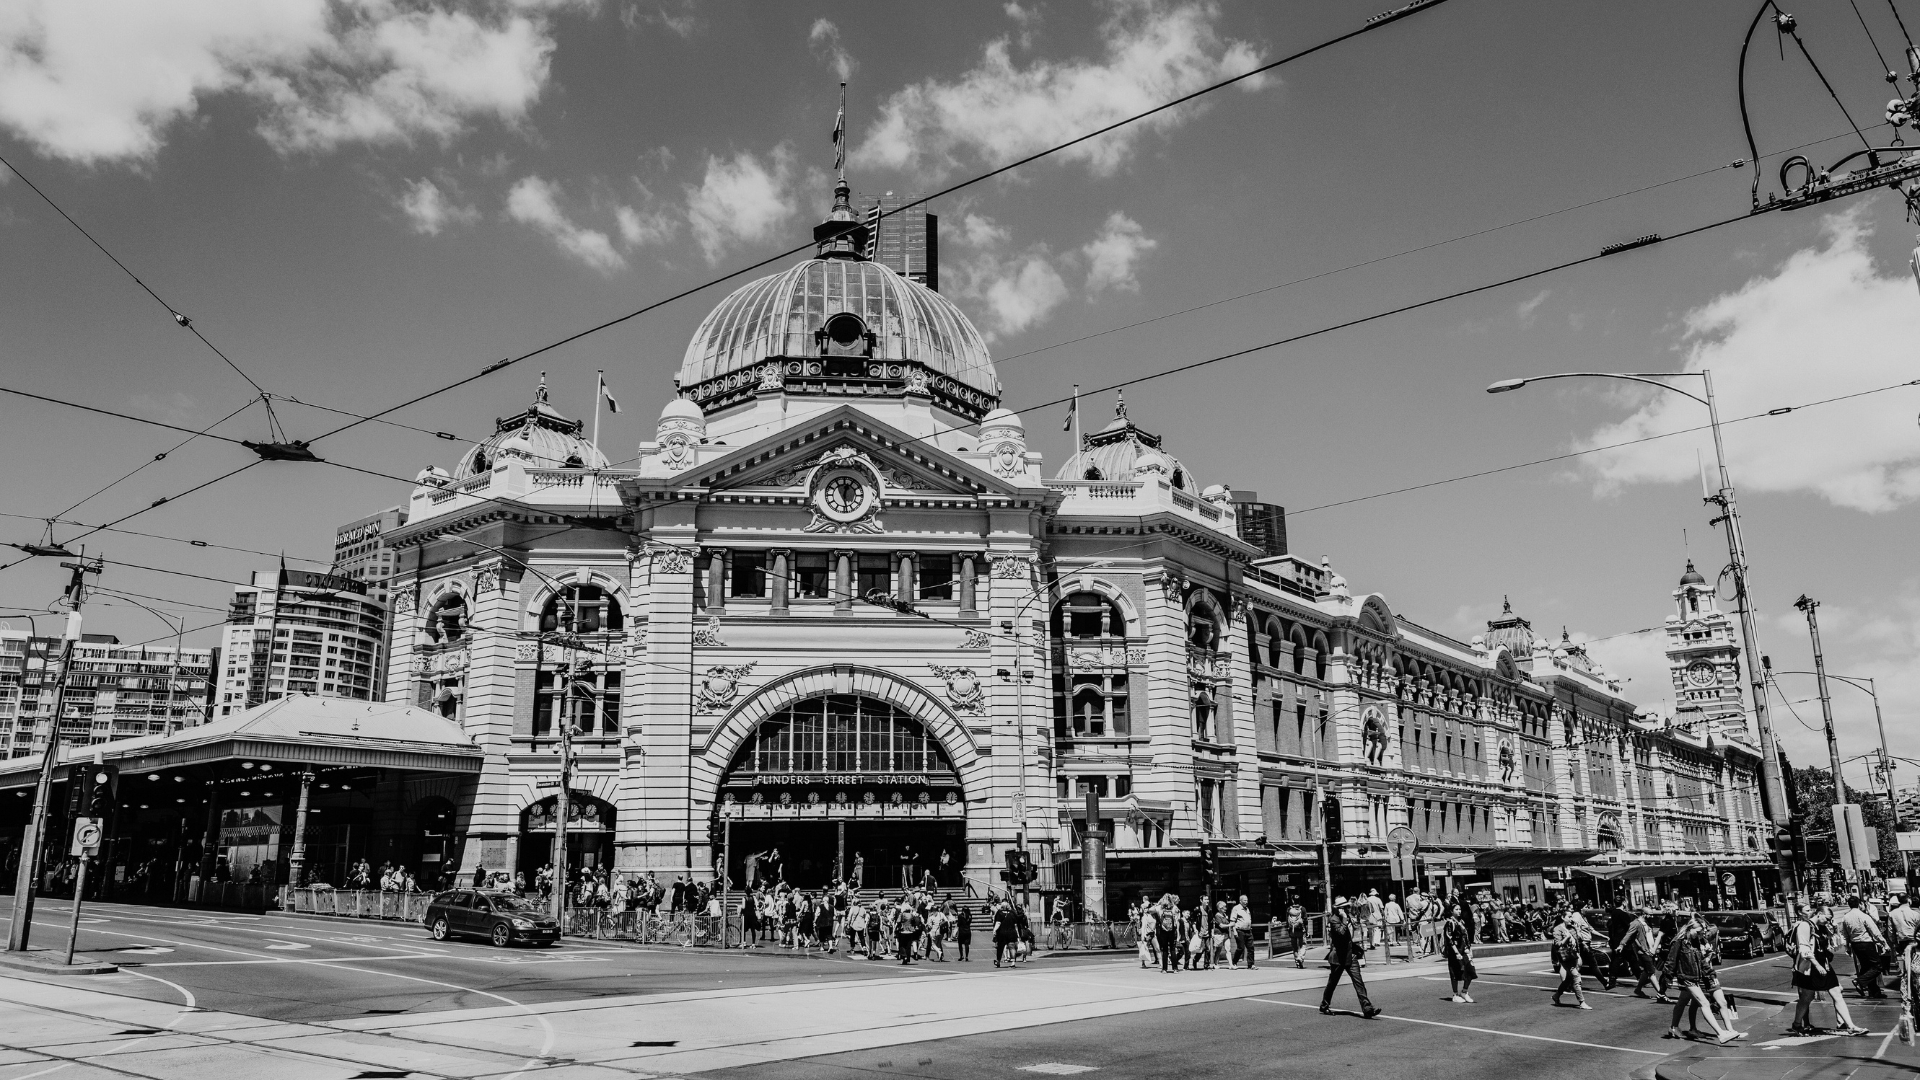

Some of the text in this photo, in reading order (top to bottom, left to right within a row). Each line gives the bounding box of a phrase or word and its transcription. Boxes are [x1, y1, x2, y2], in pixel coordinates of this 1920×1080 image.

[334, 521, 380, 546] HERALD SUN
[757, 775, 926, 785] FLINDERS STREET STATION
